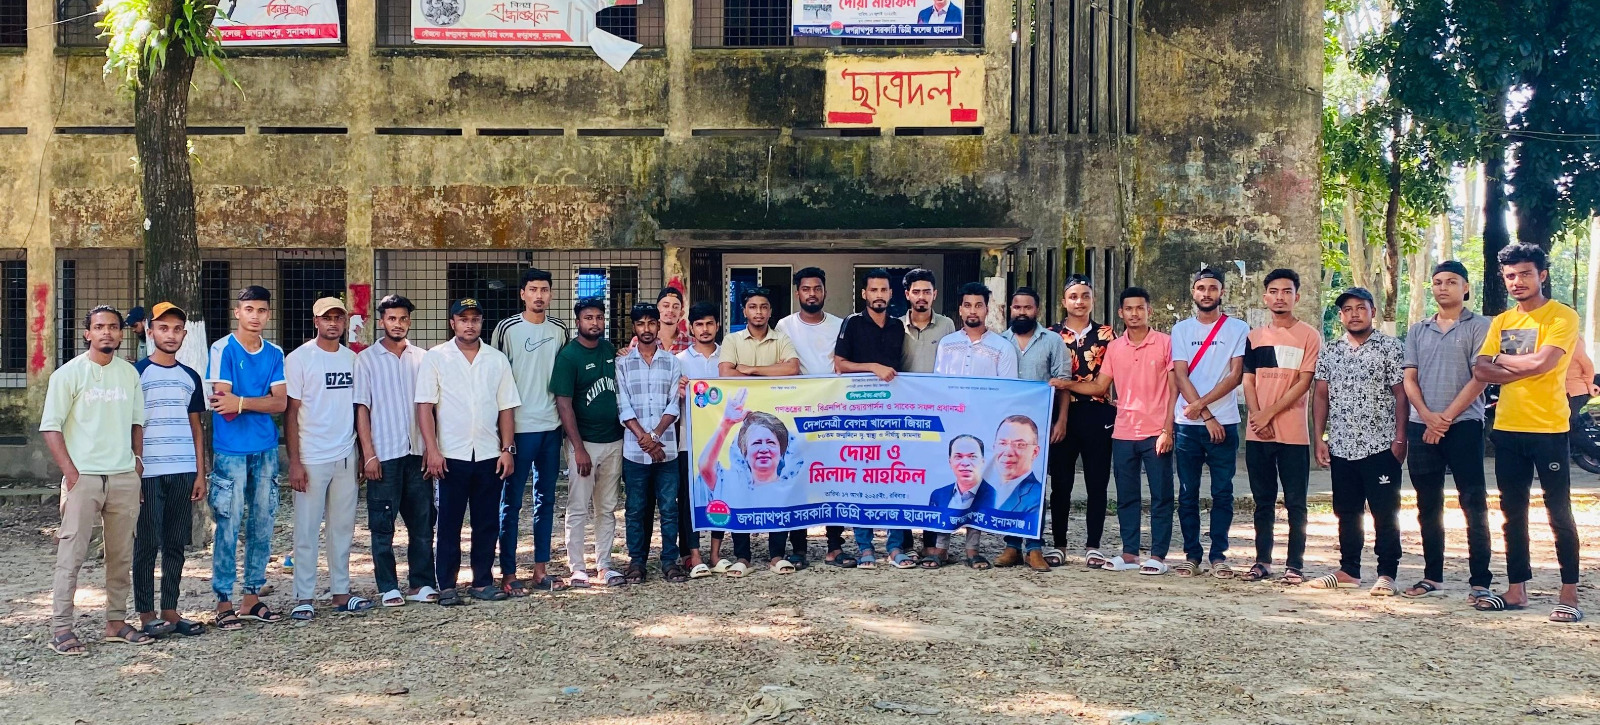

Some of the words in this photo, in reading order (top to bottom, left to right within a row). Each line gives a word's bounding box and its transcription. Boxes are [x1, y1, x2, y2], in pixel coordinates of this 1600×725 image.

[875, 25, 897, 34] সরকারি
[898, 25, 912, 34] ডিগ্রি
[913, 26, 932, 34] কলেজ
[845, 70, 955, 114] ছাত্রদল
[894, 403, 916, 411] সাবেক
[918, 403, 935, 411] সফল
[937, 402, 966, 413] প্রধানমন্ত্রী
[802, 416, 842, 431] দেশনেত্রী
[844, 418, 868, 430] বেগম
[870, 418, 901, 429] খালেদা
[904, 416, 933, 430] জিয়ার
[839, 444, 881, 463] দোয়া
[887, 445, 901, 460] ও
[809, 461, 858, 484] মিলাদ
[862, 461, 926, 485] মাহফিল
[736, 511, 791, 526] জগন্নাথপুর
[794, 503, 834, 521] সরকারি
[835, 503, 862, 521] ডিগ্রি
[864, 507, 900, 522] কলেজ
